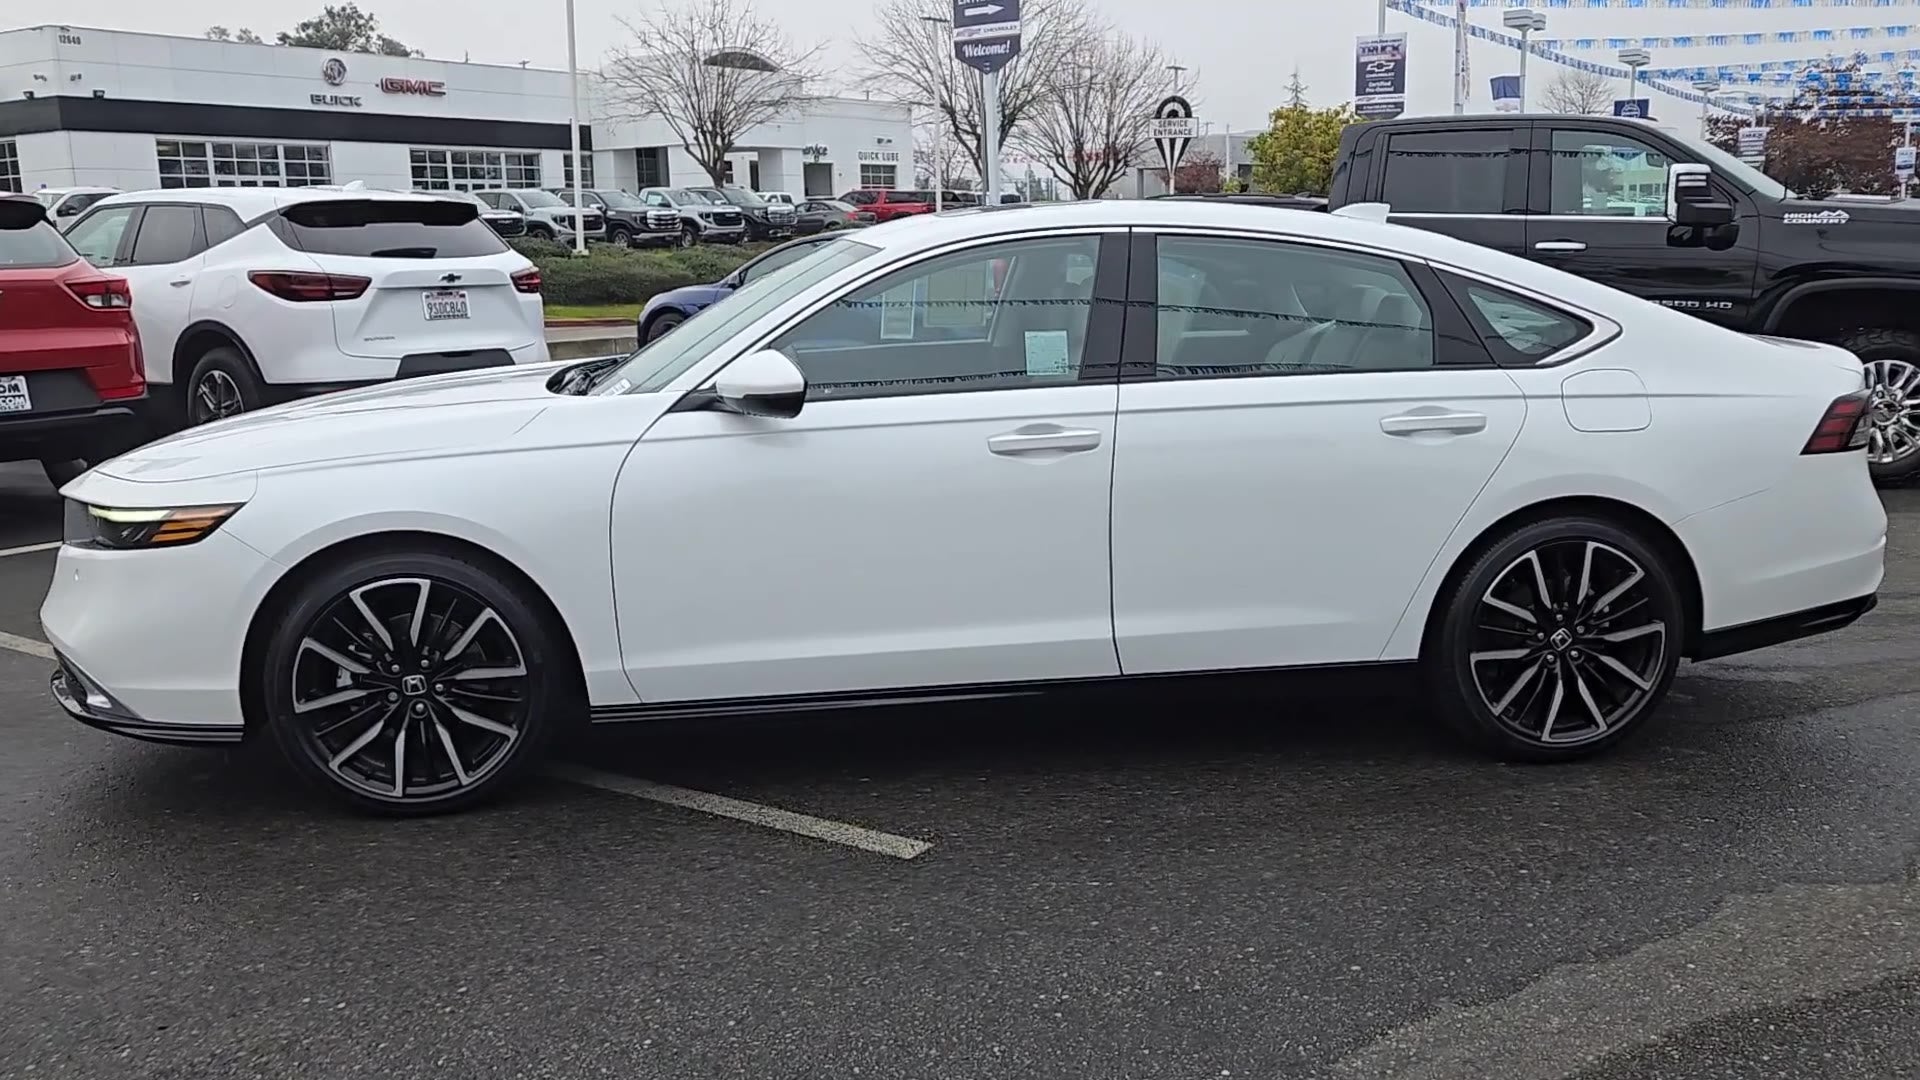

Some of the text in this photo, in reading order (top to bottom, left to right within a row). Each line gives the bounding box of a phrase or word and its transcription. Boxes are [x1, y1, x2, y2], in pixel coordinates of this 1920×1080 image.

[962, 39, 1010, 58] Welcome!
[1360, 43, 1402, 55] TRUCK
[381, 77, 447, 97] GMC
[310, 93, 363, 107] BUICK
[1158, 119, 1188, 128] SERVICE
[1153, 128, 1193, 137] ENTRANCE
[802, 145, 828, 156] ervice
[857, 151, 900, 162] QUICK LUBE
[1705, 301, 1733, 309] HD
